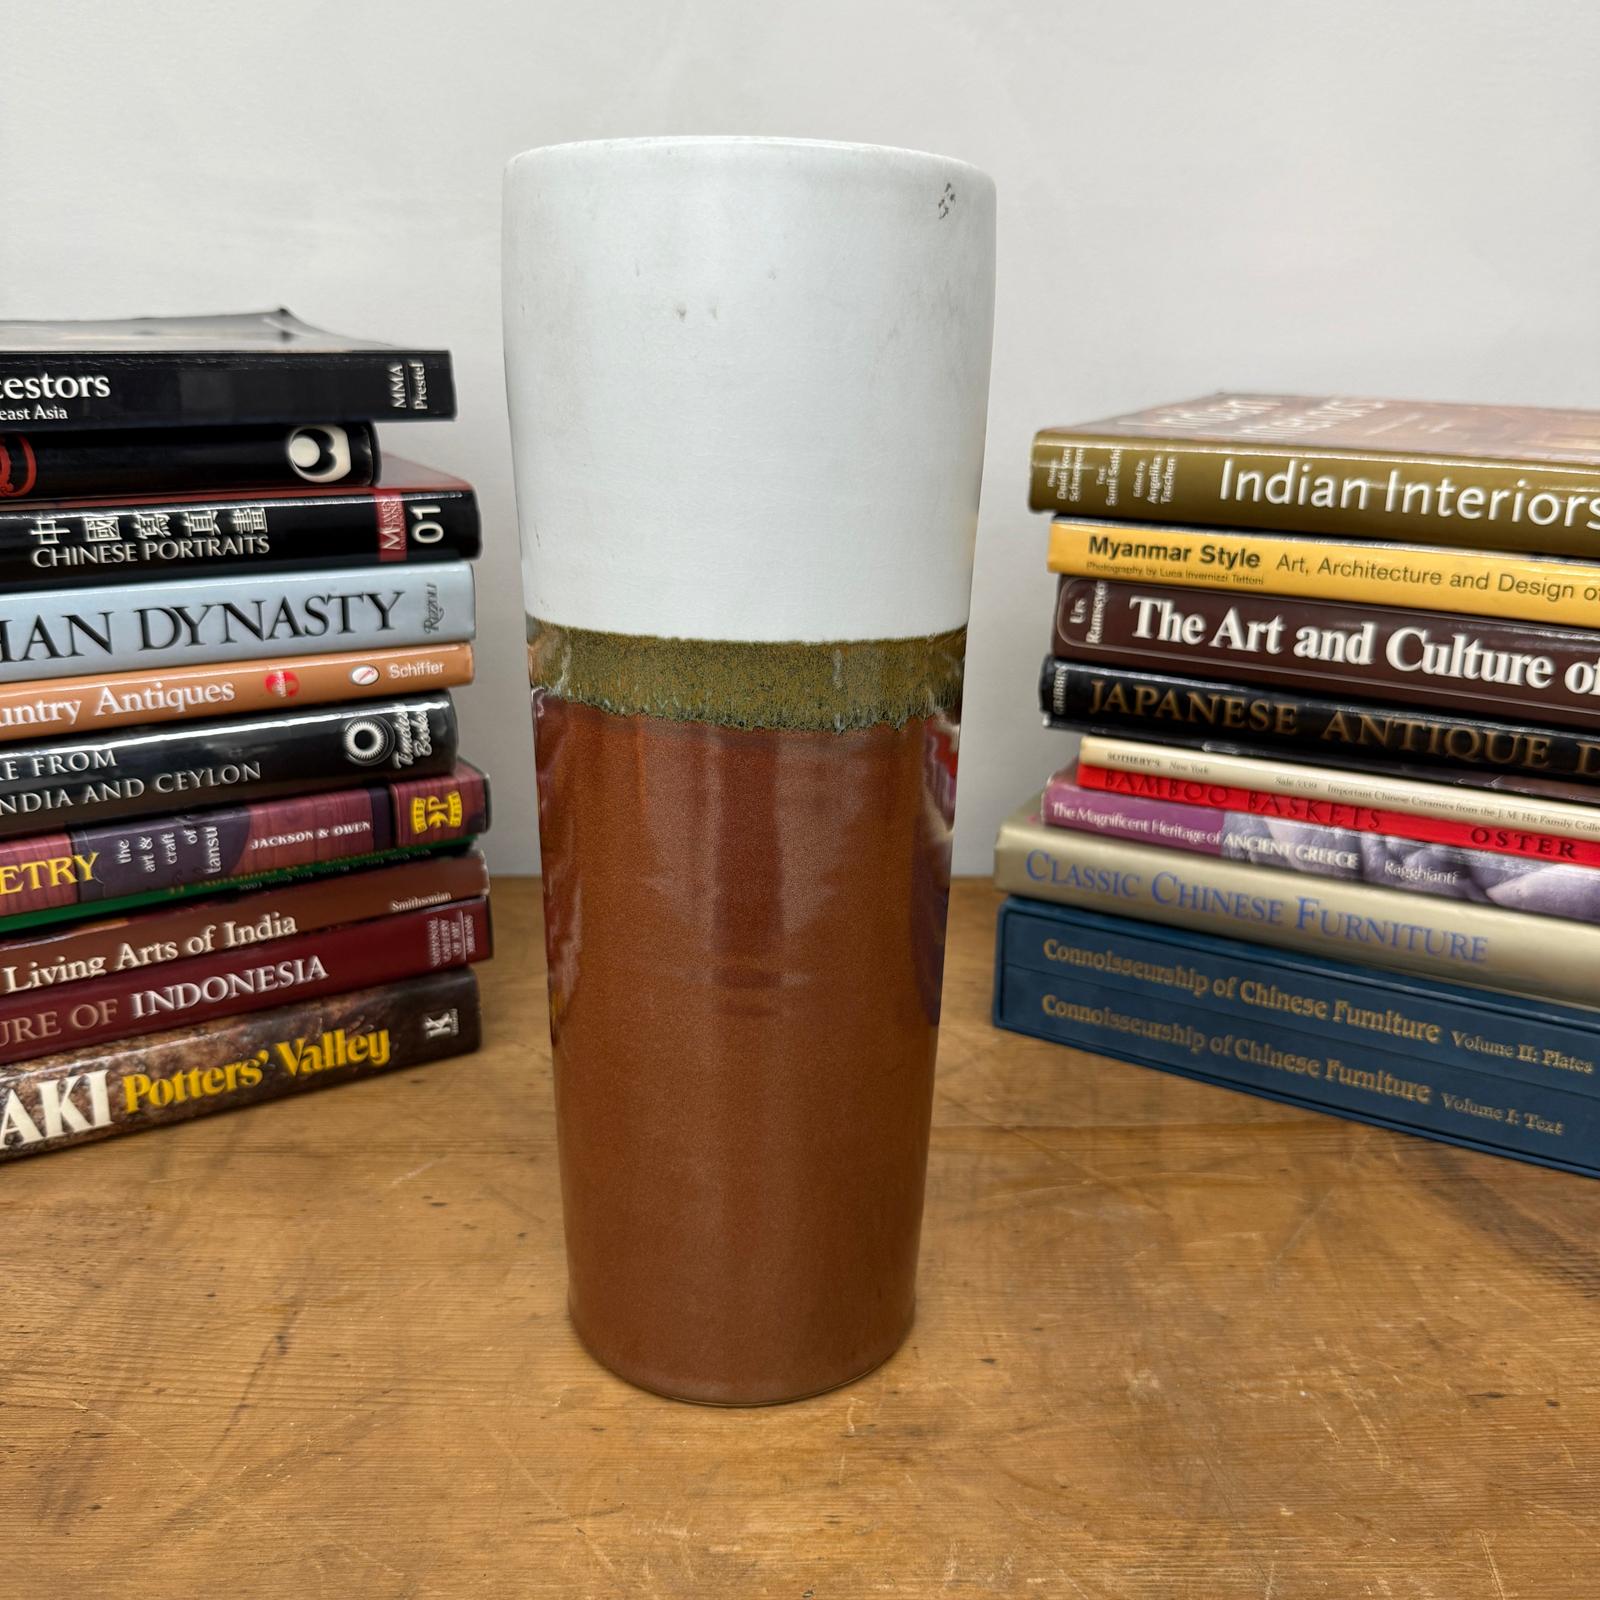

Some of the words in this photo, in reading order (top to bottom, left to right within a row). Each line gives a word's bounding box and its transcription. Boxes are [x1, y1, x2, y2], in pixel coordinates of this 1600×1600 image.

[0, 373, 111, 399] estors
[385, 362, 407, 408] MMA
[408, 359, 428, 409] Prestel
[34, 404, 69, 420] Asia
[1105, 478, 1118, 506] Sunil
[1147, 455, 1163, 504] Angelika
[1160, 456, 1177, 504] Taschen
[1219, 458, 1369, 510] Indian
[1385, 468, 1600, 530] Interiors
[410, 505, 444, 544] 01
[32, 543, 138, 568] CHINESE
[145, 535, 270, 561] PORTRAITS
[1086, 561, 1144, 577] Photography
[1146, 568, 1157, 578] by
[1088, 536, 1192, 562] Myanmar
[1200, 544, 1261, 569] Style
[1276, 553, 1310, 575] Art,
[1317, 557, 1443, 586] Architecture
[1449, 571, 1489, 591] and
[1498, 573, 1574, 602] Design
[1584, 586, 1600, 601] o
[135, 591, 406, 651] DYNASTY
[1069, 598, 1086, 624] Urs
[1129, 595, 1207, 646] The
[1209, 606, 1287, 655] Art
[1293, 621, 1377, 666] and
[1385, 626, 1556, 689] Culture
[388, 661, 445, 679] Schiffer
[94, 682, 236, 716] Antiques
[1089, 679, 1298, 736] JAPANESE
[1320, 709, 1553, 768] ANTIQUE
[0, 760, 20, 781] E
[32, 750, 118, 777] FROM
[82, 777, 145, 804] AND
[153, 761, 262, 794] CEYLON
[1106, 752, 1160, 768] SOTHEBY'S
[1168, 760, 1189, 772] New
[1190, 762, 1210, 775] York
[1104, 768, 1229, 805] BAMBOO
[1248, 793, 1380, 830] BASKETS
[1471, 826, 1577, 860] OSTER
[1326, 784, 1372, 799] Important
[1411, 796, 1454, 812] Ceramics
[1455, 804, 1478, 816] from
[1480, 807, 1496, 817] the
[1539, 815, 1573, 829] Family
[117, 838, 132, 865] the
[139, 835, 153, 850] &
[160, 831, 178, 865] craft
[182, 827, 198, 845] of
[203, 825, 222, 874] tansu
[250, 831, 314, 850] JACKSON
[316, 828, 330, 840] &
[334, 820, 371, 836] OWEN
[1052, 801, 1076, 820] The
[1075, 807, 1151, 834] Magnificent
[1151, 820, 1206, 846] Heritage
[1206, 830, 1222, 845] of
[1223, 831, 1294, 859] ANCIENT
[1294, 843, 1360, 871] GREECE
[0, 851, 99, 896] ETRY
[140, 856, 156, 873] art
[391, 891, 452, 913] Smithsonian
[1026, 849, 1140, 897] CLASSIC
[1151, 871, 1285, 926] CHINESE
[1295, 896, 1489, 963] FURNITURE
[2, 955, 107, 994] Living
[115, 940, 180, 971] Arts
[184, 924, 217, 955] of
[223, 911, 298, 948] India
[70, 999, 119, 1031] OF
[130, 955, 329, 1020] INDONESIA
[1043, 938, 1208, 996] Connoisseurship
[1213, 976, 1239, 998] of
[1240, 980, 1328, 1020] Chinese
[1333, 999, 1442, 1045] Furniture
[1452, 1030, 1514, 1059] Volume
[1542, 1048, 1594, 1076] Plates
[1042, 994, 1205, 1053] Connoisseurship
[1209, 1033, 1234, 1055] of
[1235, 1037, 1321, 1077] Chinese
[1325, 1057, 1433, 1104] Furniture
[1441, 1092, 1503, 1121] Volume
[1523, 1112, 1566, 1137] Text
[0, 1069, 114, 1150] AKI
[275, 1028, 391, 1077] Valley
